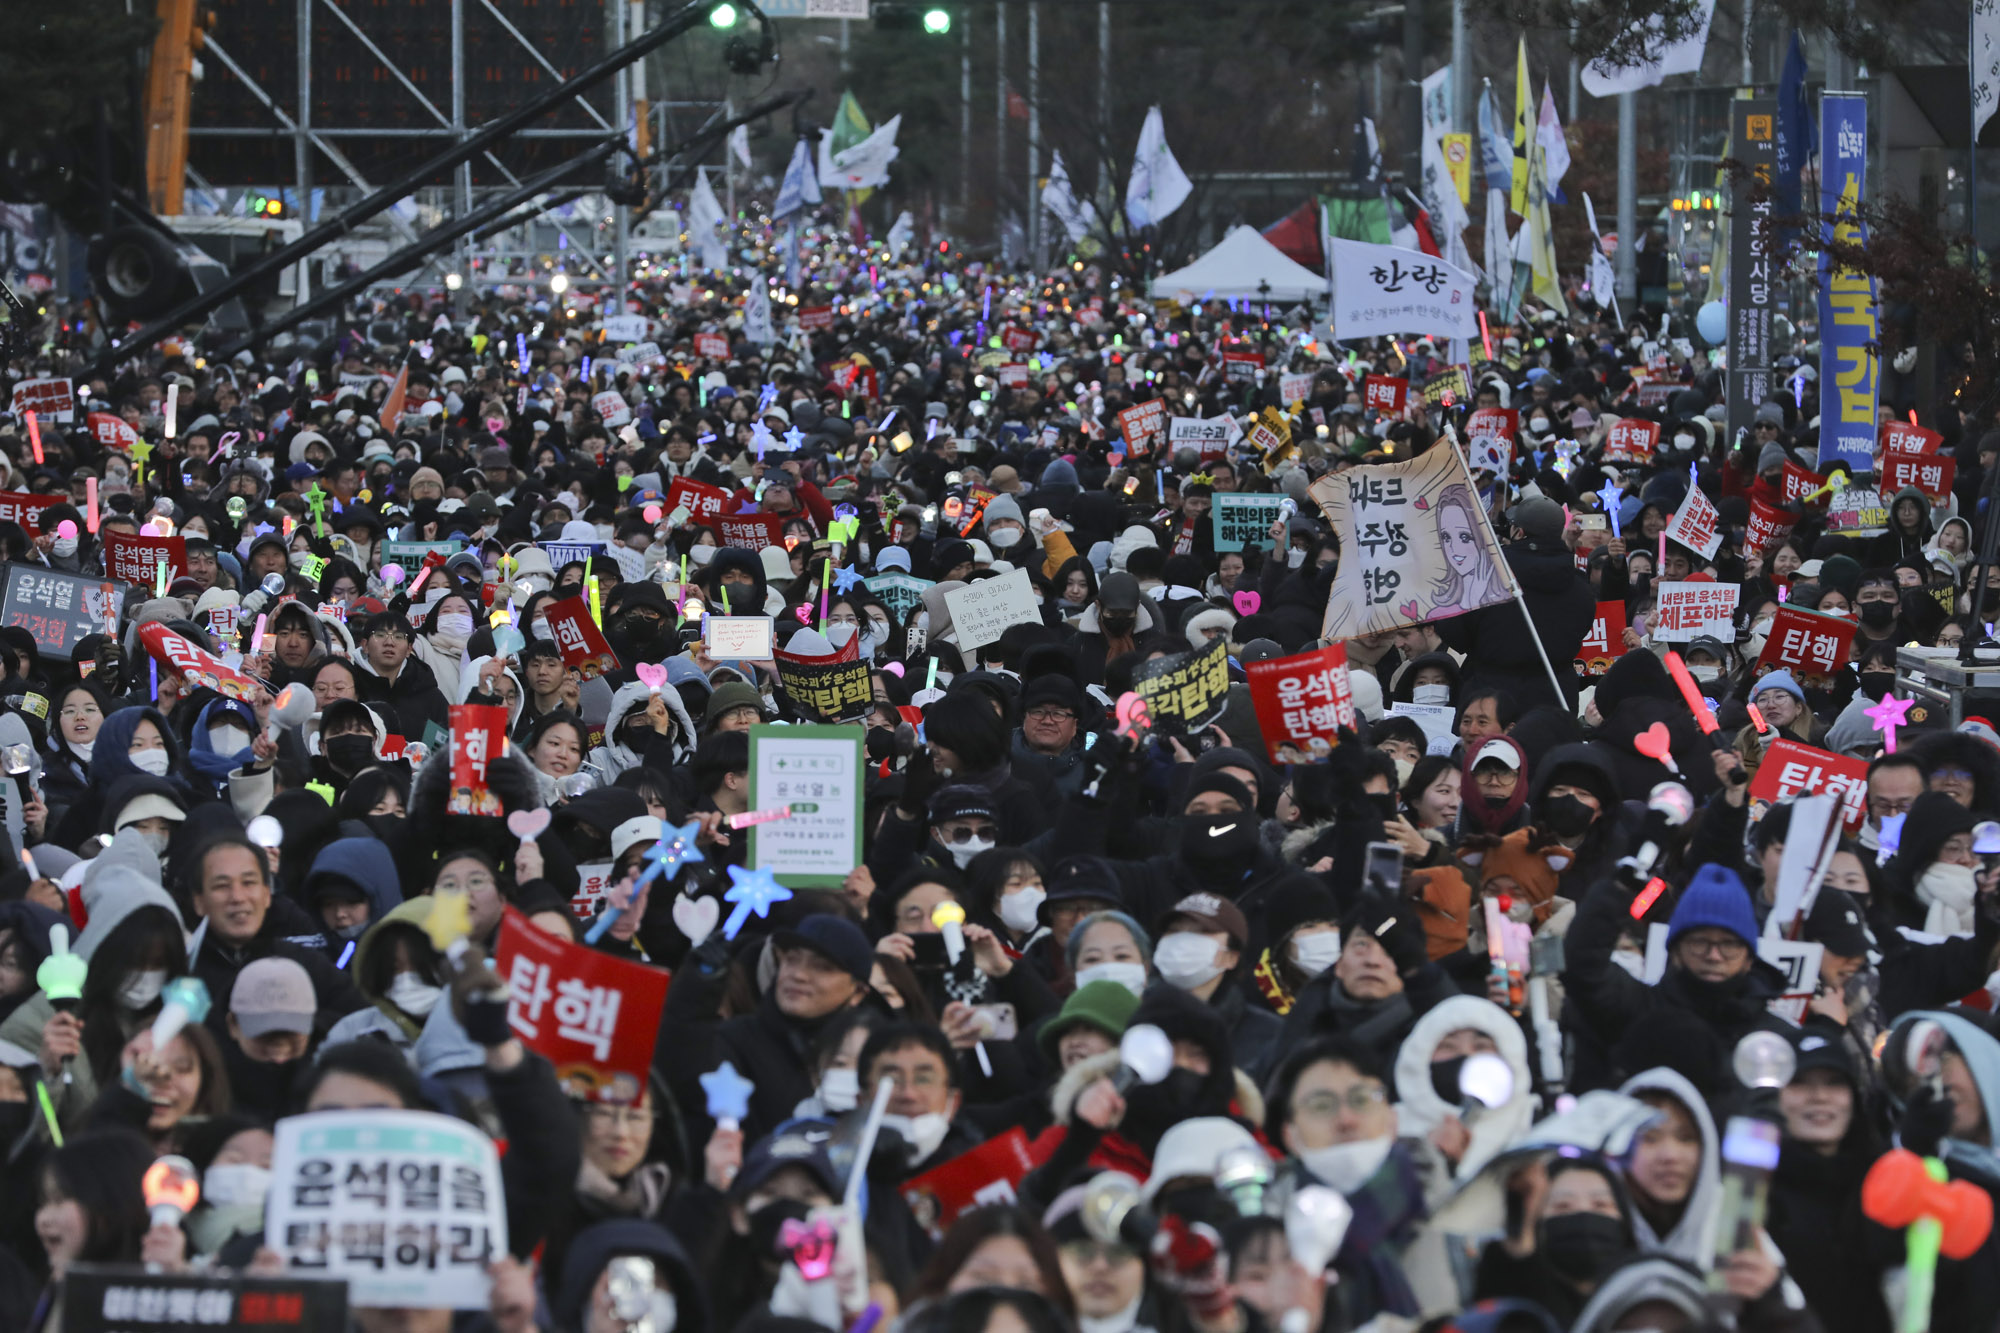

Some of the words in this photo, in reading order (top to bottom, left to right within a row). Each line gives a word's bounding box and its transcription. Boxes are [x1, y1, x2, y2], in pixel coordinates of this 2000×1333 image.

[1369, 259, 1448, 294] 한량
[1368, 383, 1396, 407] 탄핵
[97, 422, 141, 446] 탄핵
[1176, 427, 1226, 439] 내란수괴
[1610, 427, 1650, 451] 탄핵
[1889, 432, 1926, 454] 탄핵
[1787, 474, 1820, 506] 탄핵
[1895, 463, 1942, 492] 탄핵
[679, 490, 721, 518] 탄핵
[1828, 490, 1881, 513] 윤석열
[721, 522, 768, 537] 윤석열을
[1676, 507, 1698, 540] 내란범
[1826, 509, 1859, 530] 탄핵
[1858, 508, 1888, 526] 체포
[114, 543, 170, 565] 윤석열을
[549, 547, 590, 569] WIN
[17, 574, 74, 610] 윤석열
[1660, 592, 1693, 606] 내란범
[1695, 589, 1733, 602] 윤석열
[10, 611, 67, 649] 김건희
[212, 608, 236, 634] 탄
[1658, 604, 1732, 631] 체포하라
[1581, 618, 1608, 653] 핵
[1781, 627, 1838, 672] 탄핵
[781, 671, 819, 687] 내란수괴
[833, 665, 868, 683] 윤석열
[1134, 669, 1187, 696] 내란수괴
[1201, 641, 1226, 672] 윤석열
[785, 685, 815, 708] 즉각
[814, 676, 873, 716] 탄핵
[1180, 655, 1229, 721] 탄핵
[1277, 661, 1352, 708] 윤석열
[1283, 697, 1356, 739] 탄핵하
[1776, 759, 1868, 824] 탄핵
[507, 954, 621, 1061] 탄핵
[292, 1160, 487, 1211] 윤석열을
[286, 1222, 495, 1271] 탄핵하라
